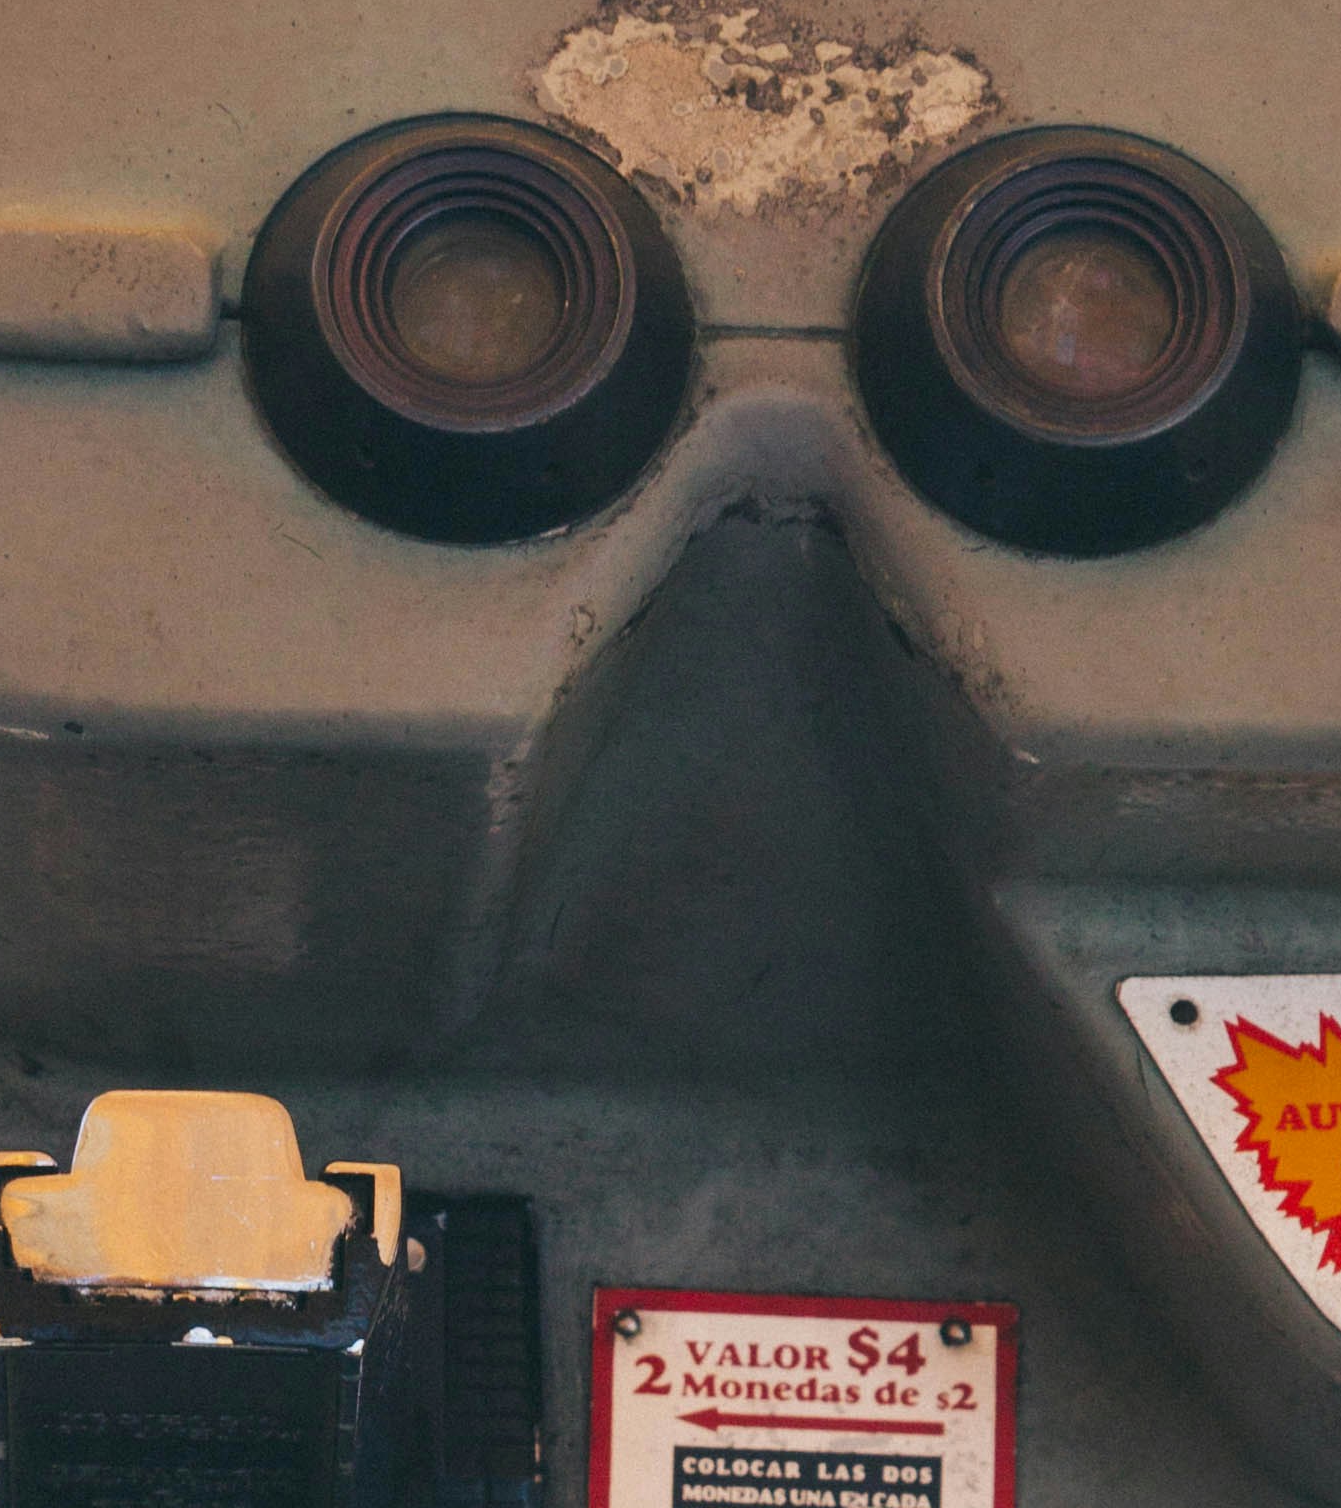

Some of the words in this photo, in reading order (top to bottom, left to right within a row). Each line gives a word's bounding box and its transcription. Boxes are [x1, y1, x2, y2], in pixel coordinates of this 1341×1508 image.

[684, 1340, 831, 1371] VALOR
[847, 1325, 927, 1377] $4
[633, 1354, 672, 1396] 2
[681, 1372, 861, 1404] Monedas
[873, 1380, 920, 1406] de
[681, 1456, 802, 1479] COLOCAR
[817, 1461, 866, 1483] LAS
[882, 1464, 933, 1485] DOS
[681, 1483, 787, 1506] MONEDAS
[789, 1488, 837, 1508] UNA
